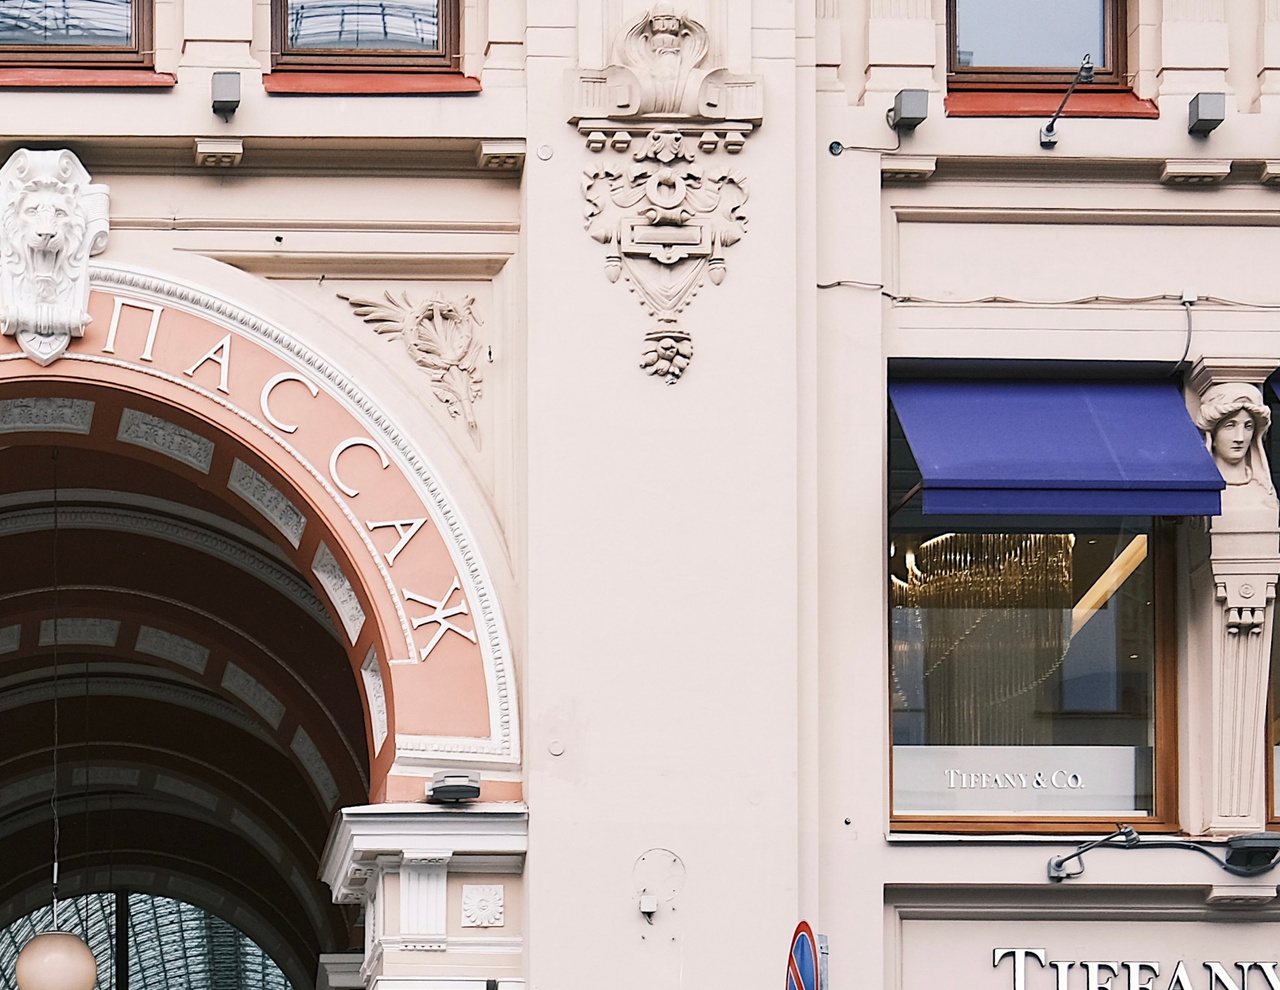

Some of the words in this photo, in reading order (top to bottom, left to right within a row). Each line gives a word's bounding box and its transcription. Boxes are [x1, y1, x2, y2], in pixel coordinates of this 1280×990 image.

[102, 297, 476, 661] ПАССАЖ
[944, 769, 1028, 789] TIFFANY
[1032, 772, 1048, 789] &
